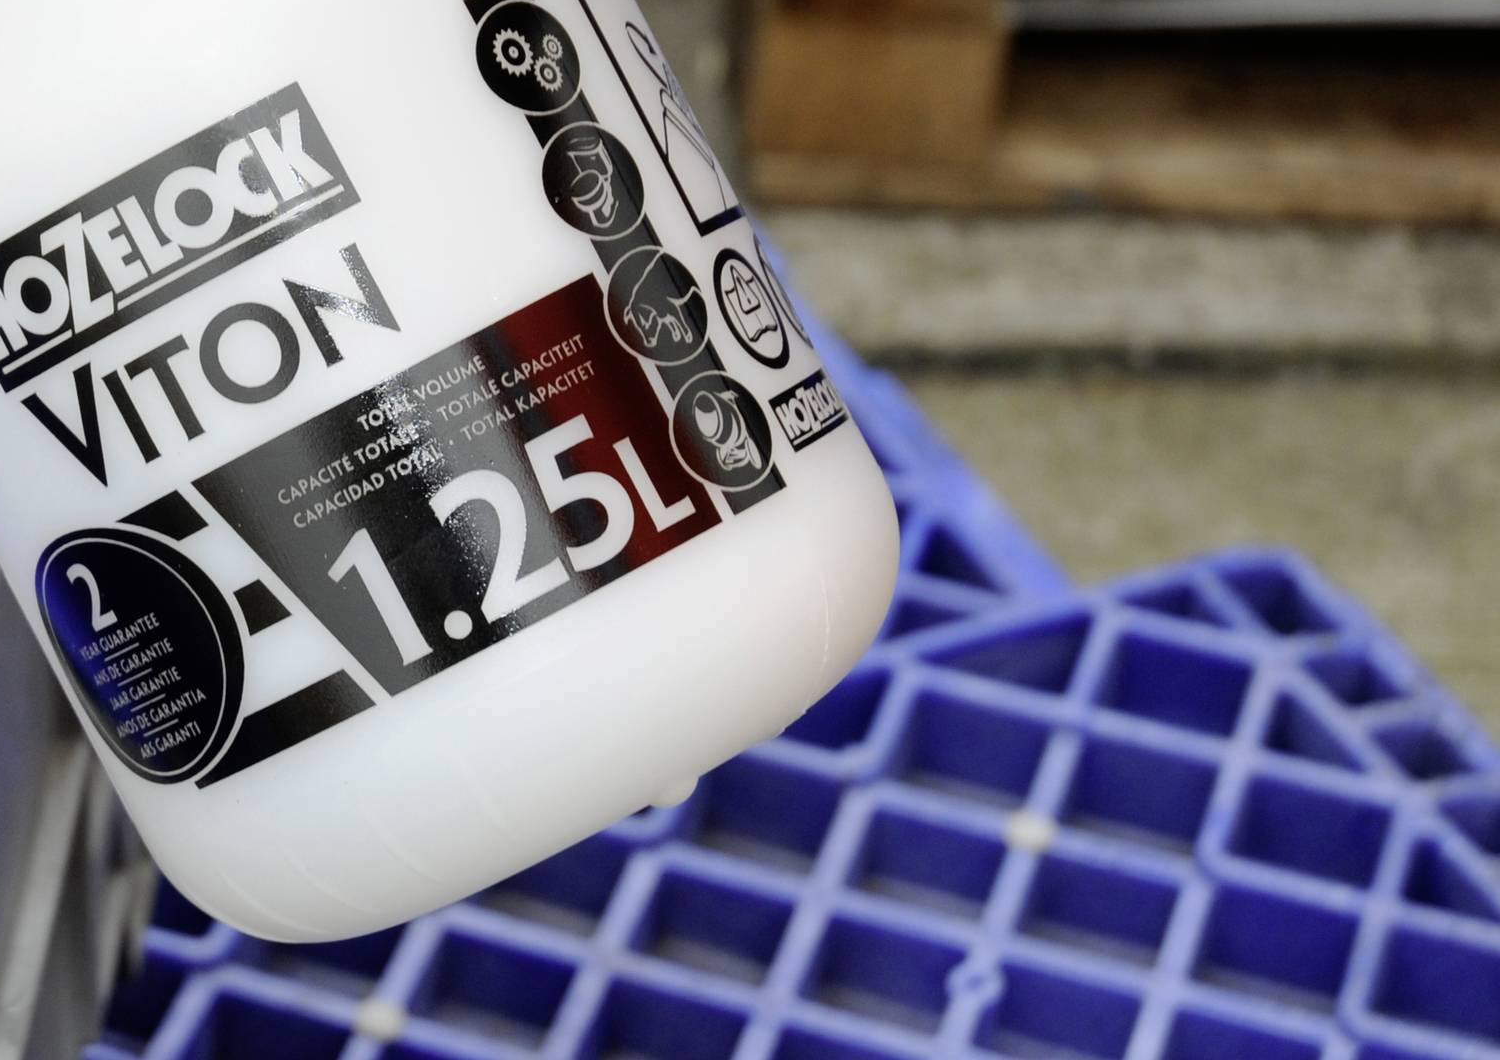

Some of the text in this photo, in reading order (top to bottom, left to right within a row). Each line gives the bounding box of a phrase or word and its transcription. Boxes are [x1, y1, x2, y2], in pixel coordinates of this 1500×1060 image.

[20, 242, 402, 488] VITON
[357, 355, 486, 431] TOTAL VOLUME
[278, 334, 585, 505] CAPACITÉ TOTALE TOTALE CAPACITEIT
[293, 360, 596, 528] CAPACIDAD TOTAL TOTAL KAPACITET
[327, 413, 696, 668] 1.25L
[66, 563, 118, 632] 2
[79, 612, 160, 661] YEAR GUARANTEE
[93, 637, 174, 687] ANS DE GARANTIE
[109, 666, 182, 712] JAAR GARANTIE
[137, 712, 152, 730] DE
[149, 689, 207, 725] GARANTIA
[156, 721, 202, 753] GARANTI
